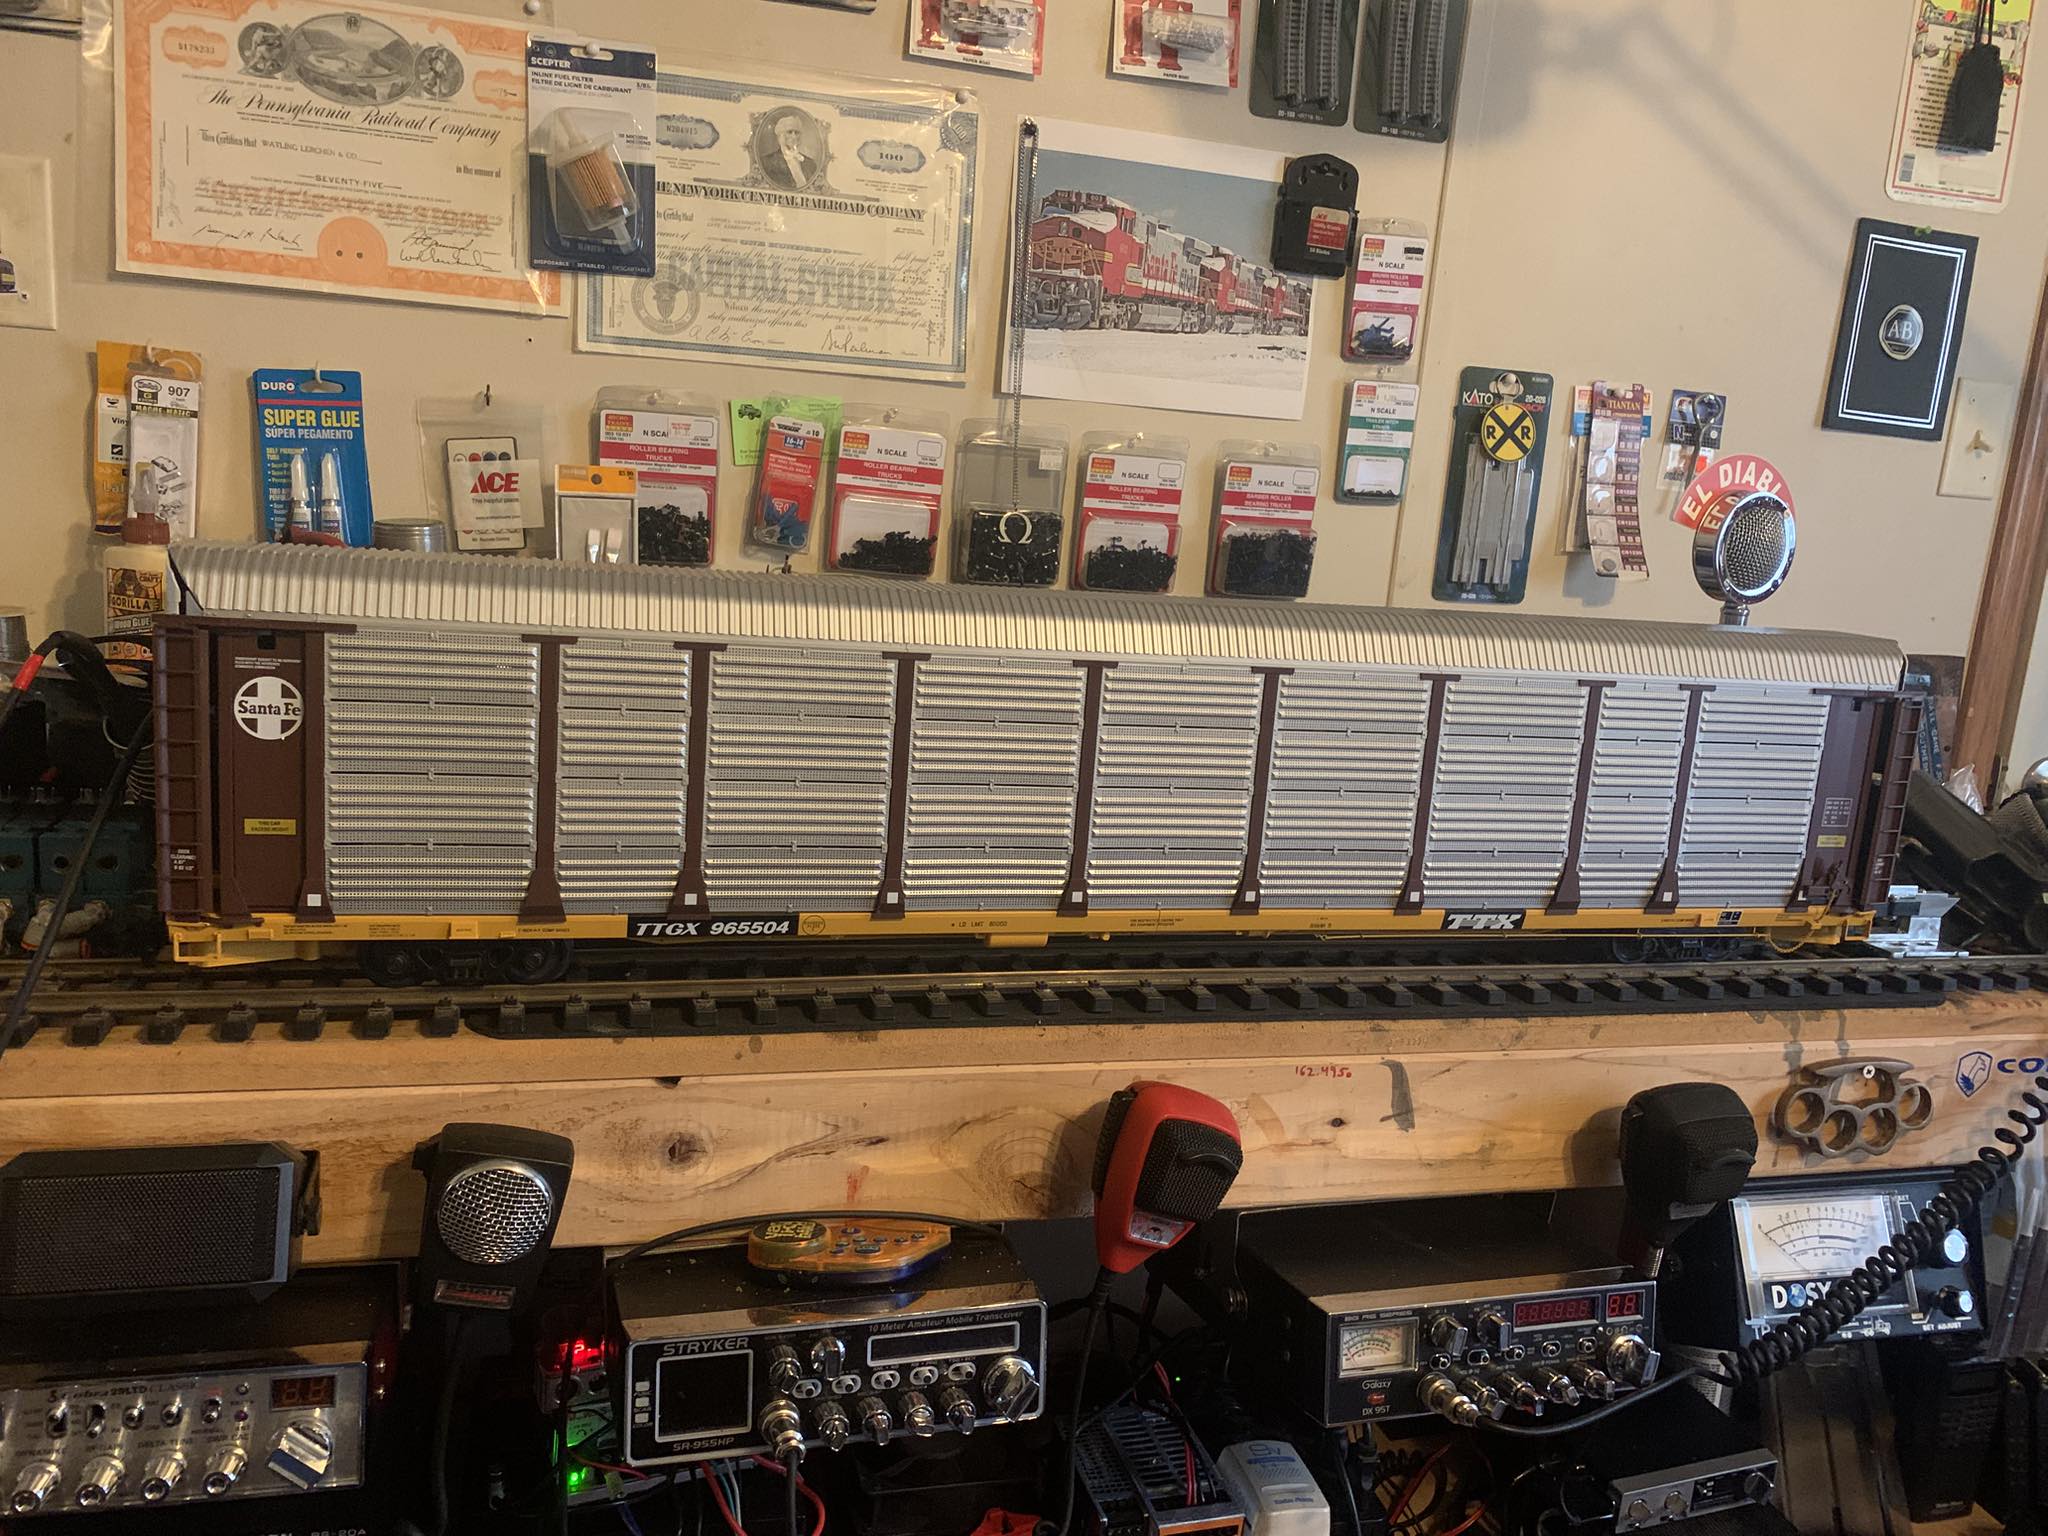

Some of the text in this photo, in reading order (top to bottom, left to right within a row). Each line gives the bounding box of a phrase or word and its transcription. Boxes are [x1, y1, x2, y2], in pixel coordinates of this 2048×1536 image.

[531, 57, 571, 69] SCEPTER
[593, 85, 632, 94] CARBURANT
[239, 92, 351, 121] Pennsylvania
[361, 107, 428, 130] Railroad
[428, 116, 501, 146] Company
[879, 152, 904, 161] 100
[673, 182, 701, 197] NEW
[701, 186, 740, 201] YORK
[741, 190, 800, 208] CENTRAL
[800, 196, 865, 216] RAILROAD
[866, 204, 927, 222] COMPANY
[534, 259, 569, 267] DISPOSABLE
[168, 386, 190, 397] 907
[261, 381, 295, 391] DURO
[1462, 388, 1493, 405] KATO
[264, 408, 361, 428] SUPER GLUE
[265, 425, 353, 440] SÚPER PEGAMENTO
[1486, 425, 1531, 440] R R
[629, 445, 689, 455] ROLLER BEARING
[884, 448, 907, 457] SCALE
[864, 461, 917, 473] ROLLER BEARING
[878, 471, 902, 480] TRUCKS
[1128, 472, 1149, 480] SCALE
[470, 471, 519, 494] ACE
[1109, 486, 1158, 495] ROLLER BEARING
[1683, 483, 1712, 521] EL
[110, 595, 150, 610] GORILLA
[132, 616, 149, 627] GLUE
[238, 699, 301, 716] Santa Fe
[1447, 914, 1522, 929] TTX
[636, 922, 700, 936] TTGX
[710, 921, 790, 935] 965504
[1997, 1057, 2048, 1074] CO
[869, 1311, 1024, 1332] 10 Meter Amateur Mobile Transceiver
[1923, 1324, 1935, 1332] SET
[663, 1337, 749, 1356] STRYKER
[1362, 1379, 1392, 1391] Galaxy
[1362, 1407, 1374, 1416] DX
[673, 1437, 734, 1451] SR-955HP
